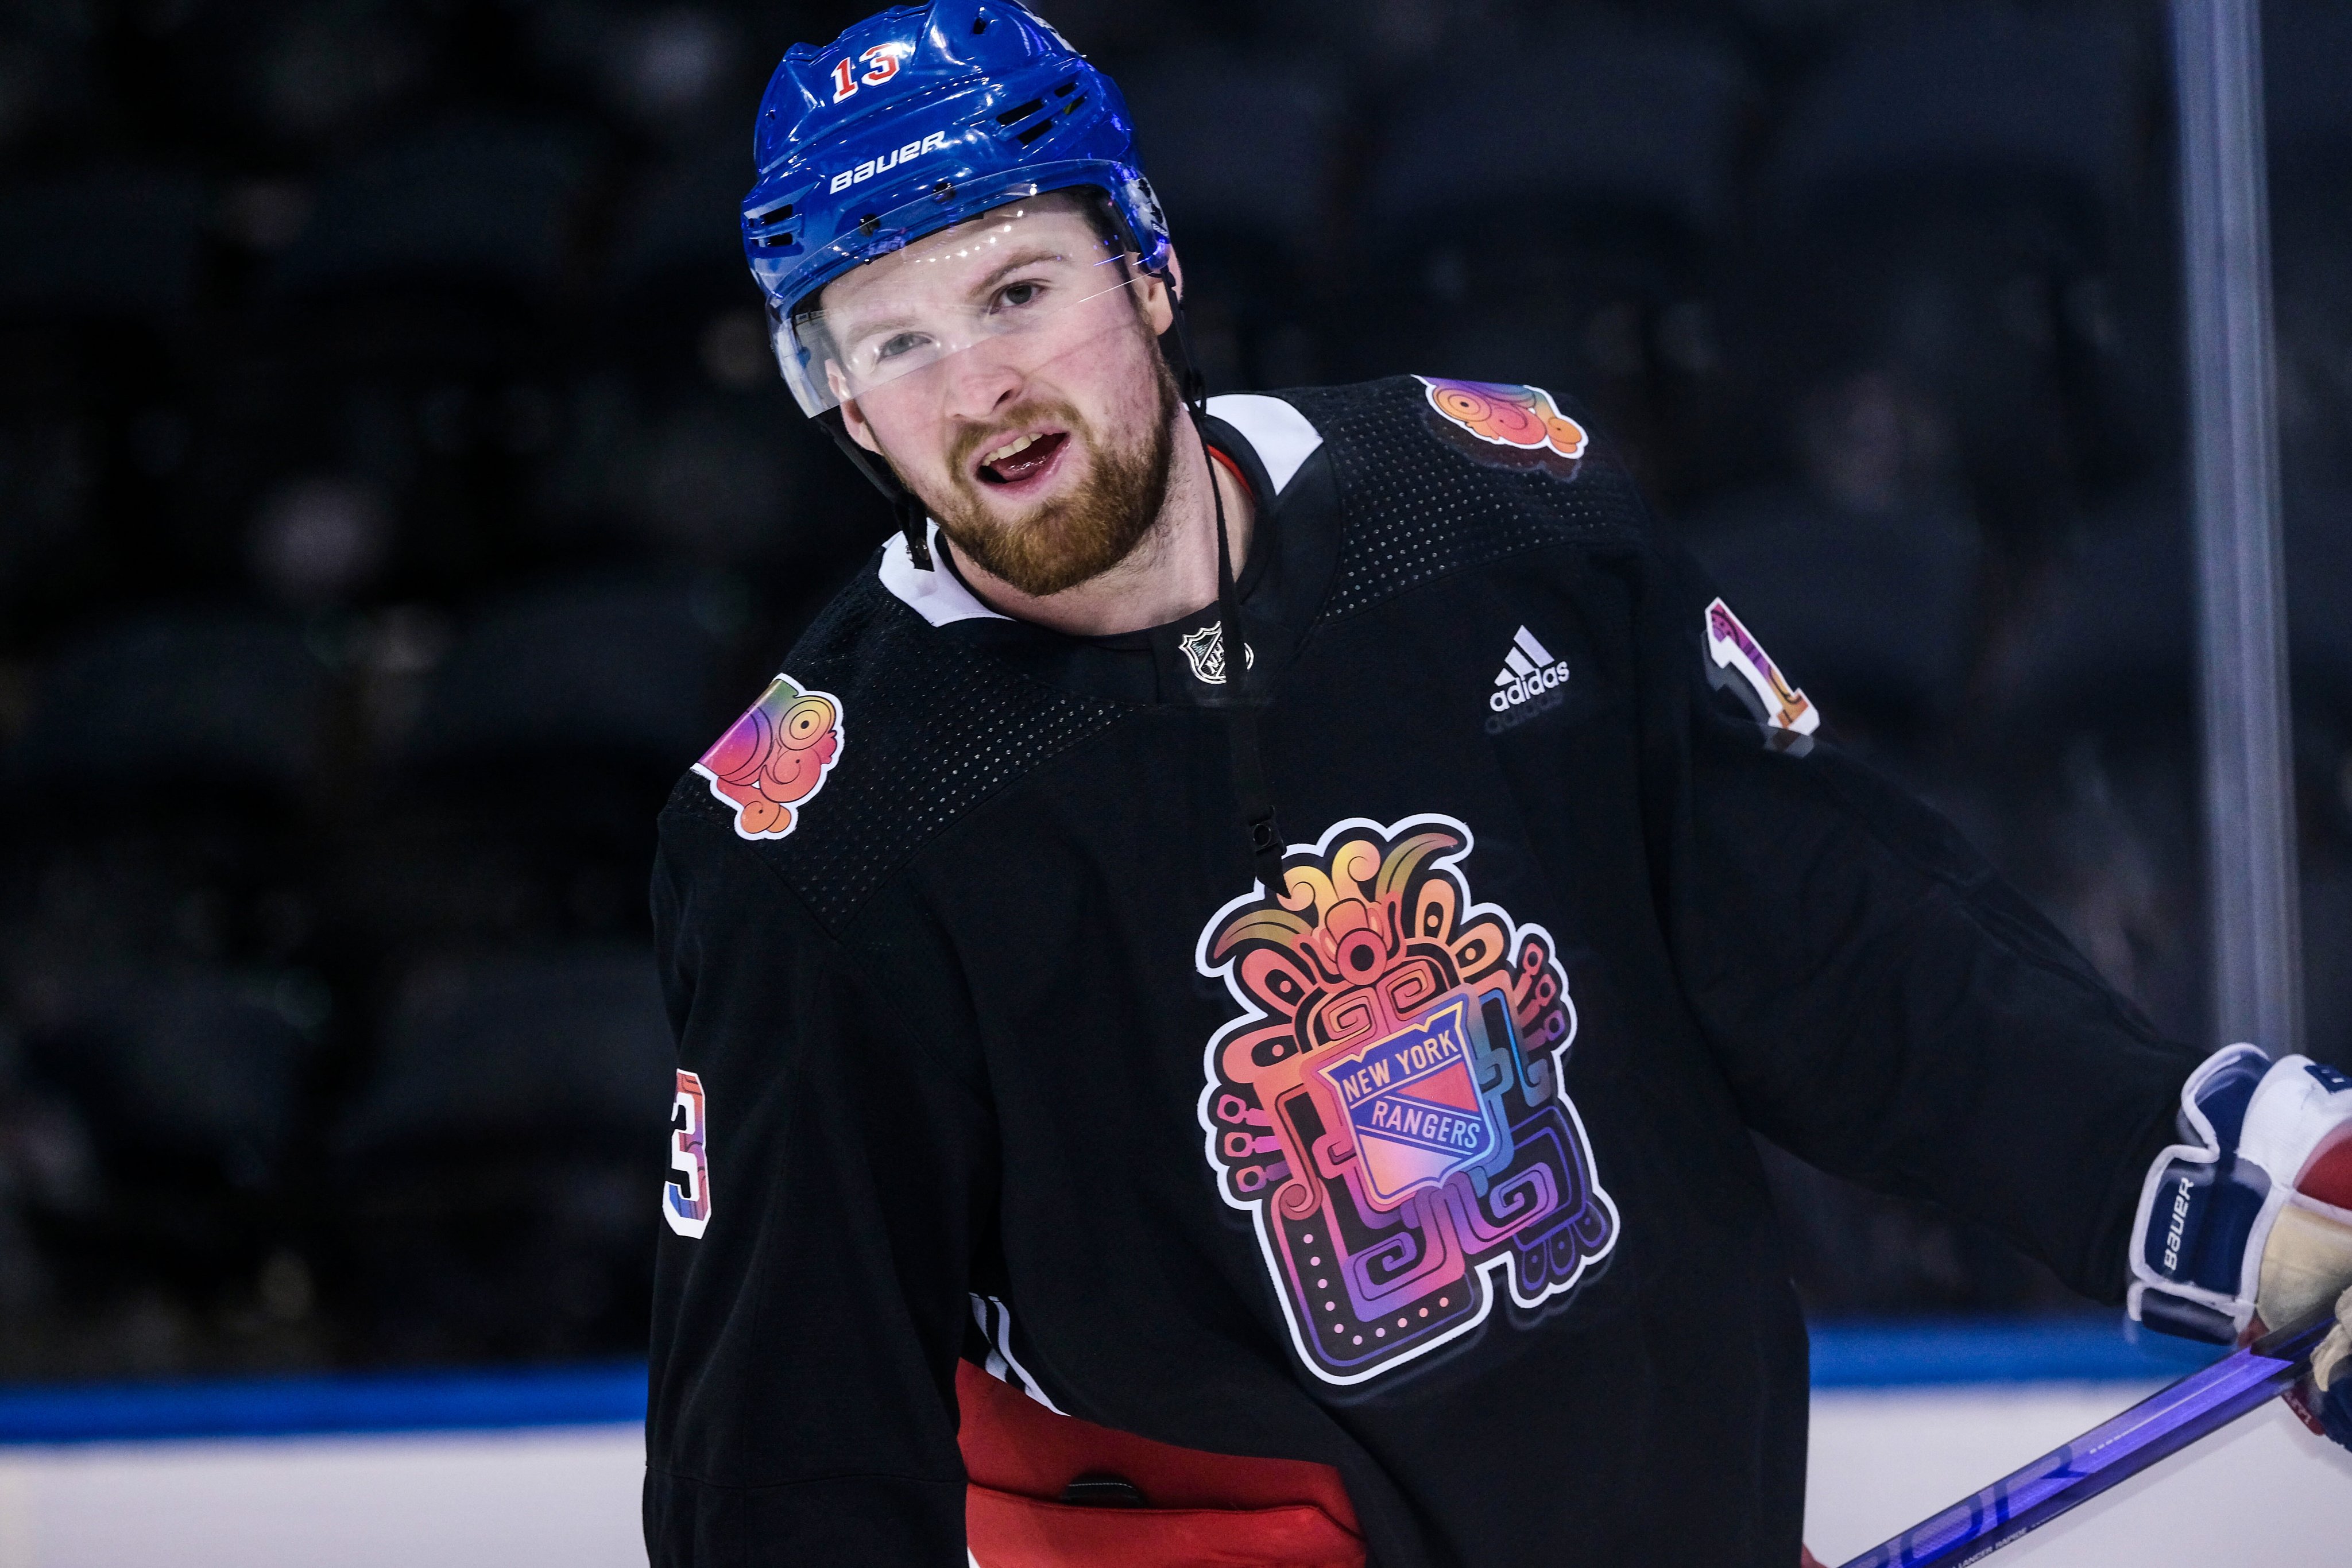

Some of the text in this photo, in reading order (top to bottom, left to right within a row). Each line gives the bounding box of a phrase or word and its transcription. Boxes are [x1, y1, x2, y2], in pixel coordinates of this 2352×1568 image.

[830, 42, 900, 104] 13
[1490, 661, 1569, 712] adidas
[1705, 597, 1820, 735] 1
[1343, 1029, 1459, 1102] NEW YORK
[662, 1068, 711, 1239] 3
[1371, 1101, 1480, 1148] RANGERS
